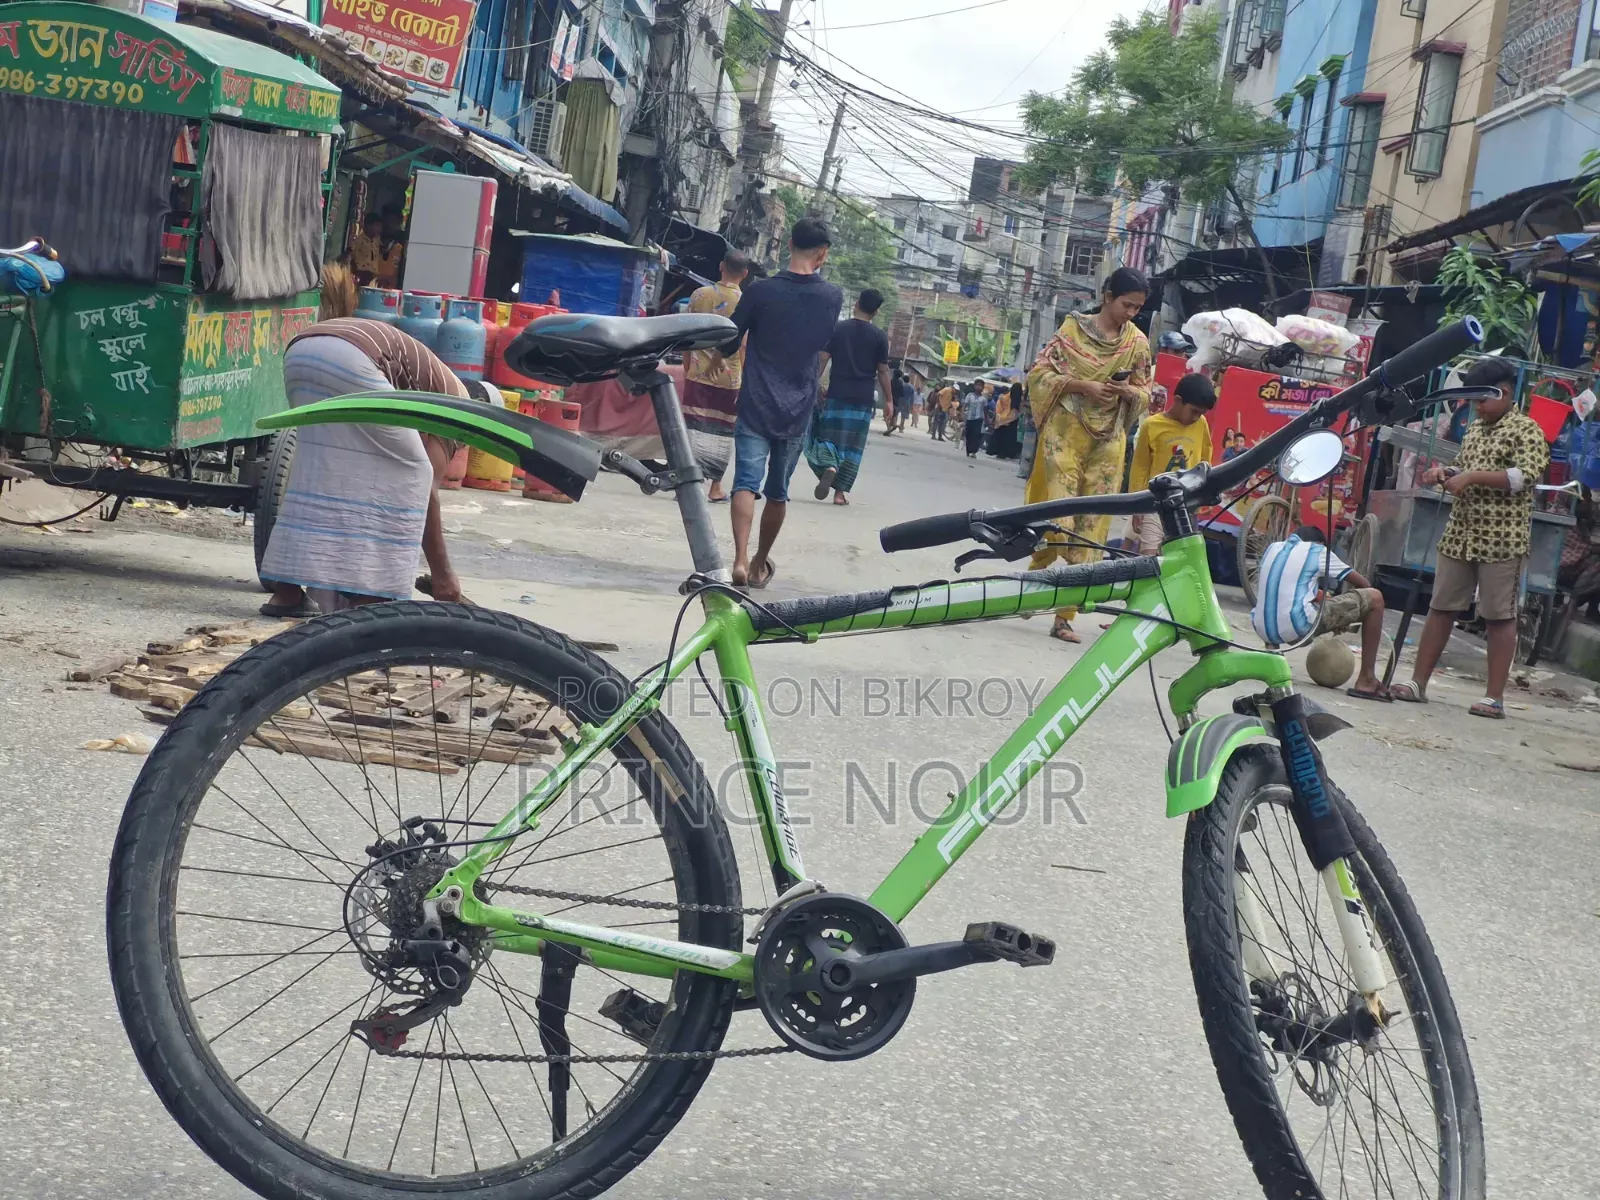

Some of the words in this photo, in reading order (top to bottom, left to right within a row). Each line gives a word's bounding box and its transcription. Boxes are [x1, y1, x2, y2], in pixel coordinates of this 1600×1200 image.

[27, 19, 109, 68] ভ্যান
[390, 8, 461, 47] বেকারী
[74, 308, 106, 330] চল
[109, 302, 148, 329] বন্ধু
[97, 332, 147, 363] স্কুলে
[110, 360, 151, 394] যাই
[1260, 381, 1281, 400] কী
[1281, 388, 1309, 401] মজা
